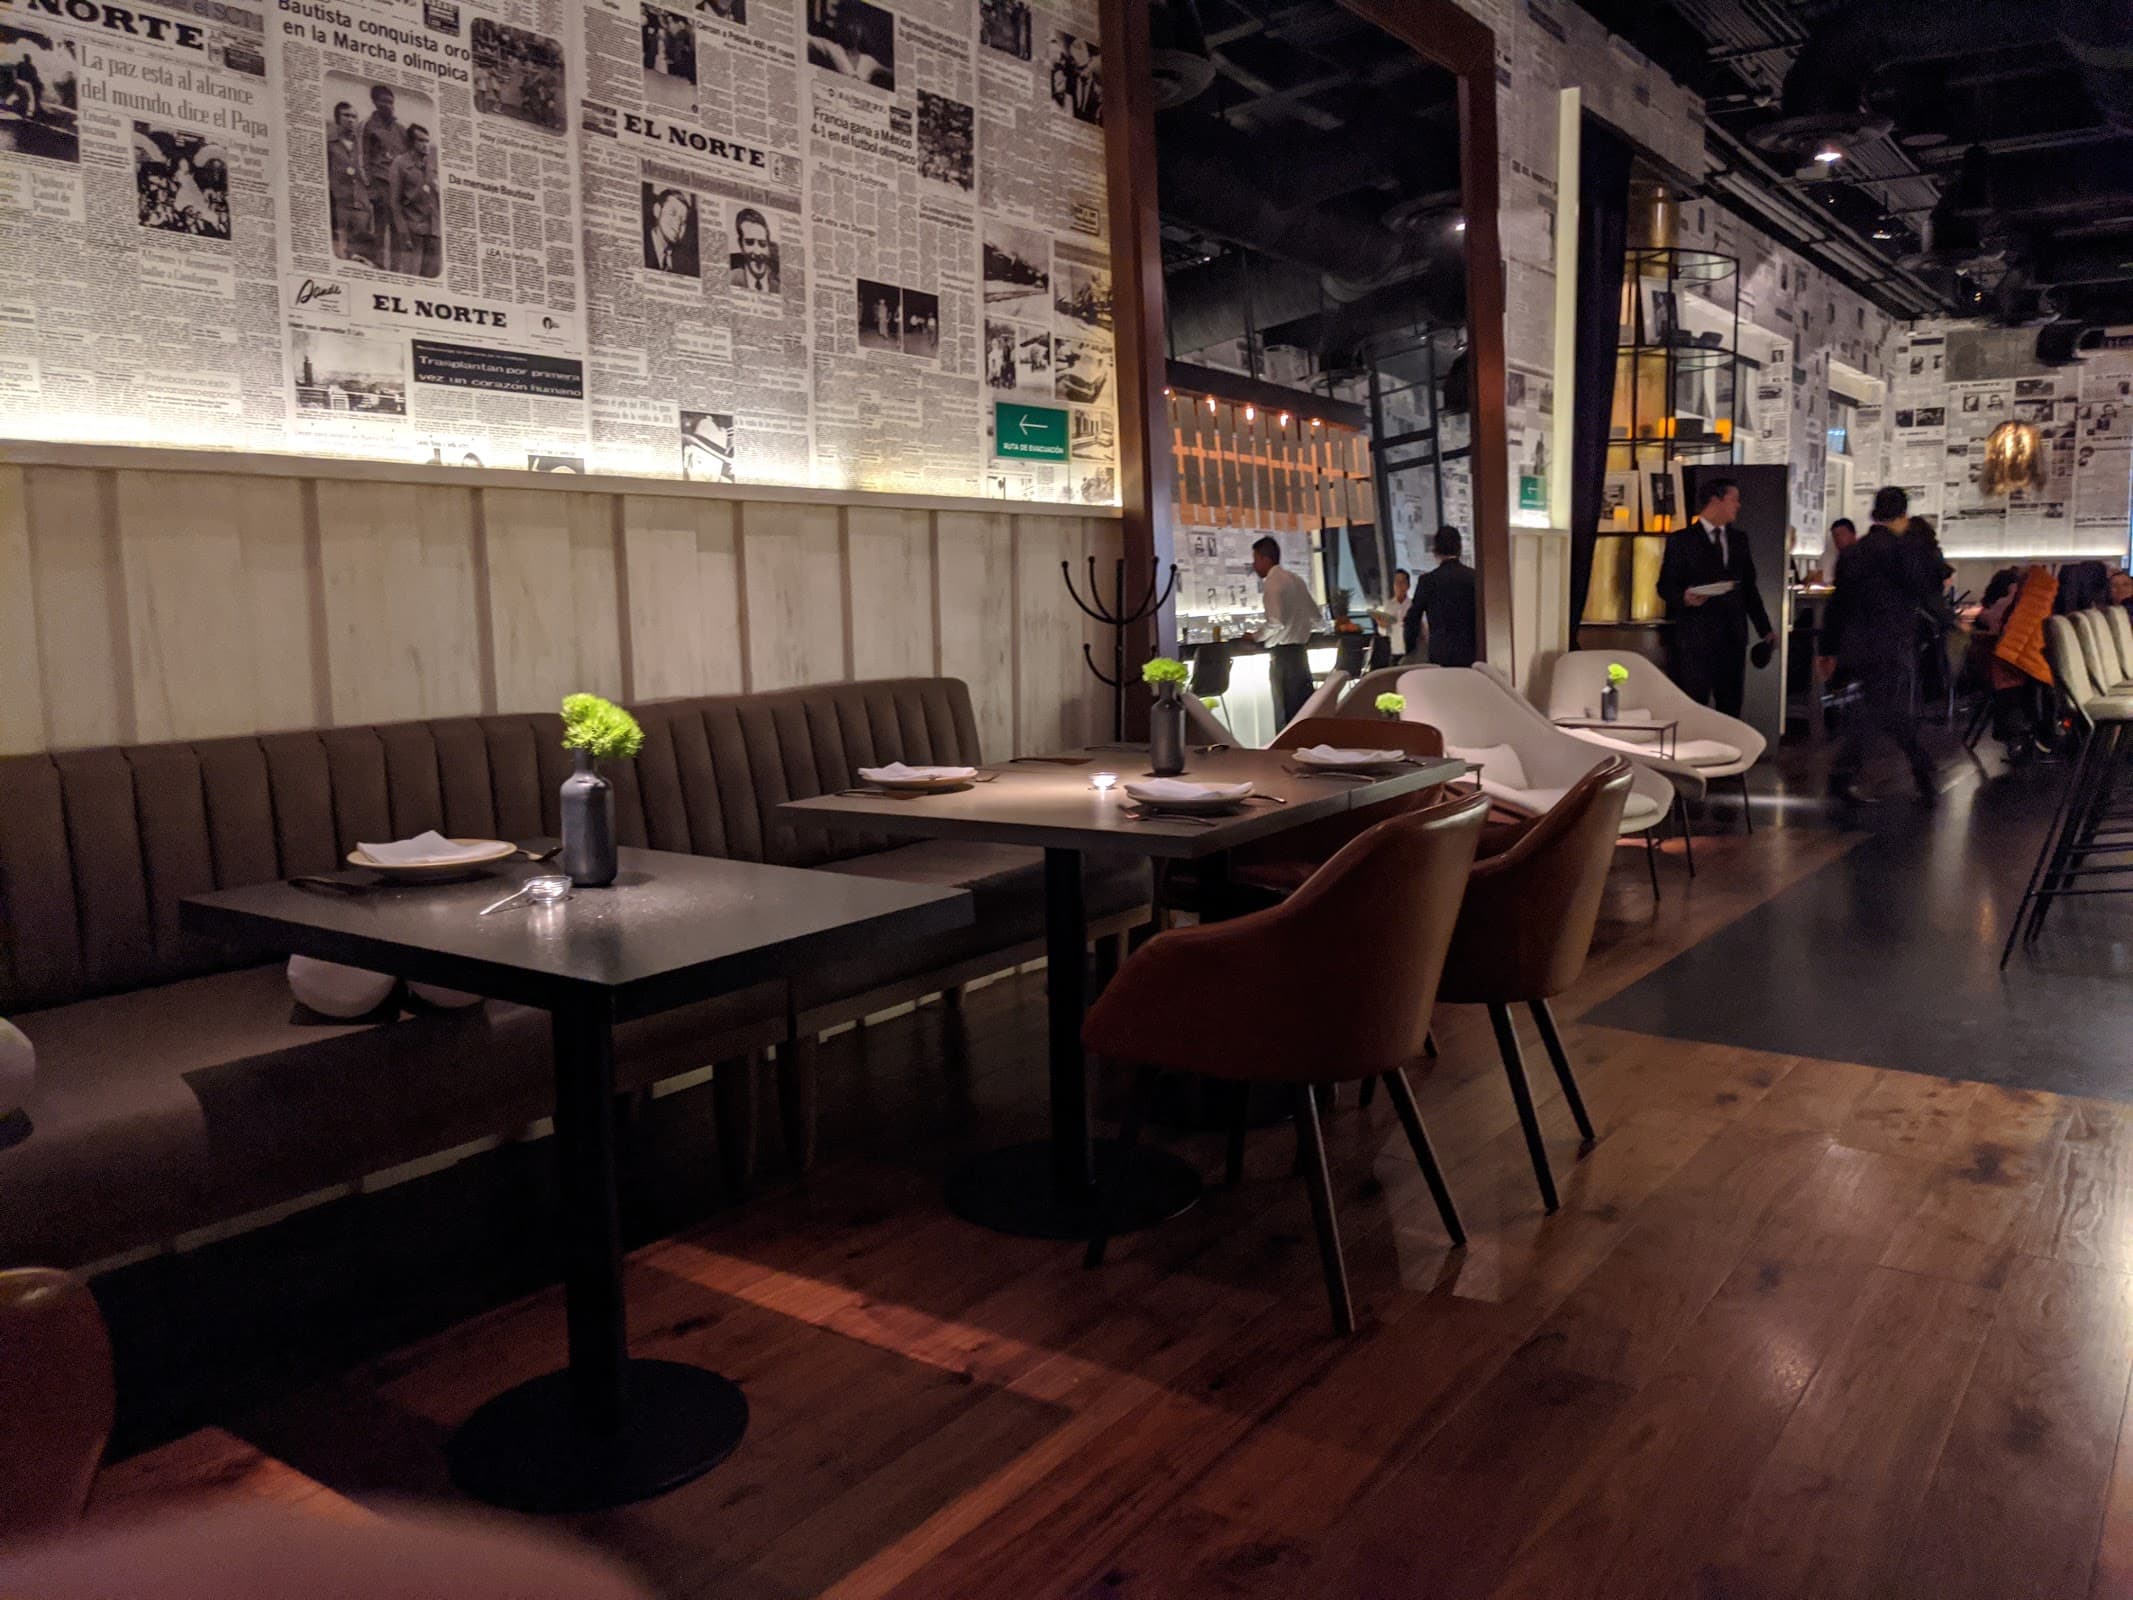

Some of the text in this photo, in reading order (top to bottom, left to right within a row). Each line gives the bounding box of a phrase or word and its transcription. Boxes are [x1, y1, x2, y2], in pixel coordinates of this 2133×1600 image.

[278, 0, 471, 61] Bautista conquista oro
[283, 21, 305, 38] en
[311, 24, 327, 44] la
[333, 29, 397, 63] Marcha
[81, 45, 103, 71] La
[108, 58, 138, 77] paz
[178, 70, 192, 91] al
[196, 74, 254, 105] alcance
[81, 77, 107, 103] del
[178, 98, 209, 124] dice
[213, 108, 226, 129] el
[231, 109, 269, 139] Papa
[813, 105, 849, 129] Francia
[623, 113, 766, 169] EL NORTE
[827, 130, 841, 142] en
[841, 133, 850, 145] el
[373, 294, 508, 329] EL NORTE
[418, 374, 444, 383] vez
[448, 376, 468, 385] un
[530, 383, 582, 397] humano
[506, 366, 529, 376] por
[531, 370, 581, 382] primera
[1019, 444, 1028, 452] DE
